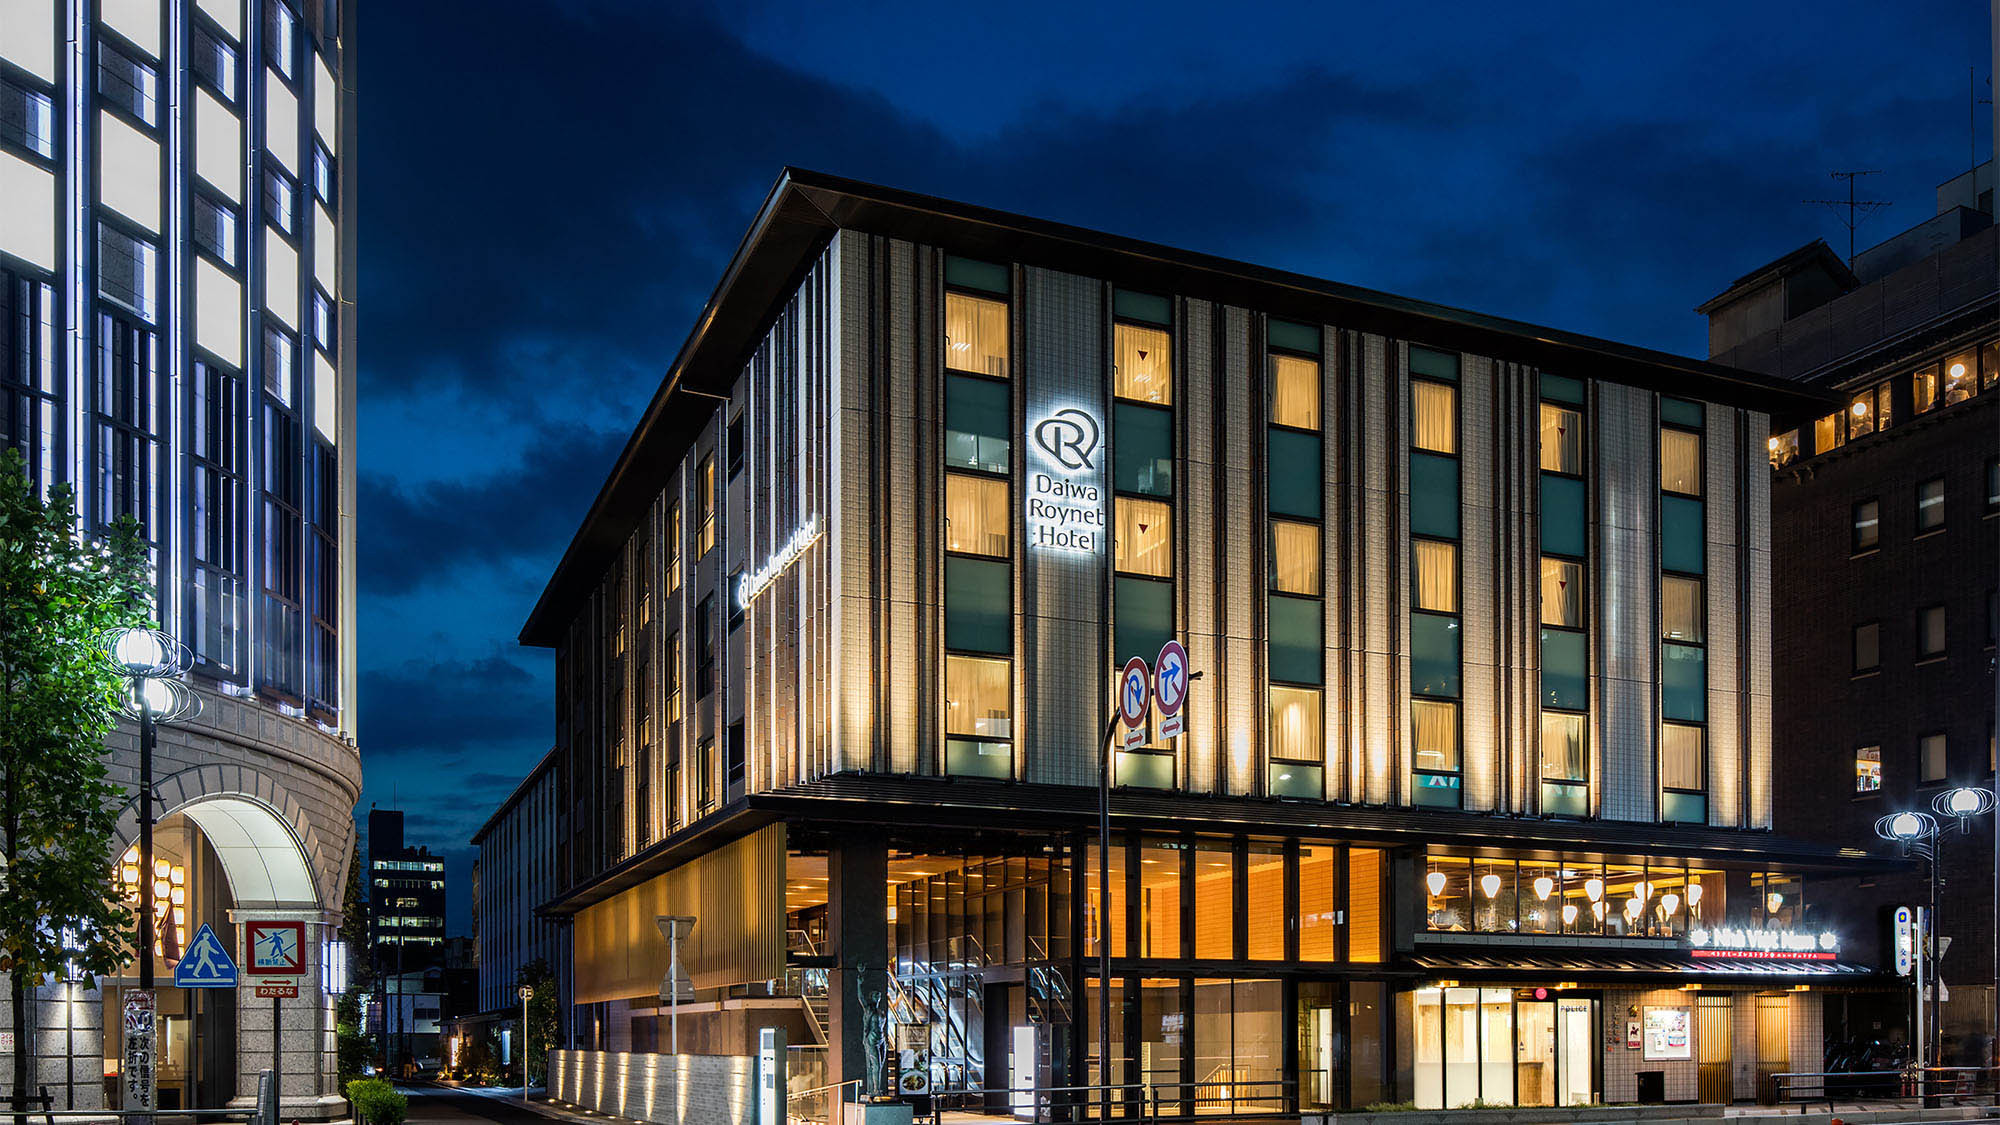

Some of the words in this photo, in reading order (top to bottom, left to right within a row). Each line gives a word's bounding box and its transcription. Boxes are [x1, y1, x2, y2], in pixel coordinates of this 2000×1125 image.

[1036, 474, 1098, 501] Daiwa
[1030, 498, 1104, 526] Roynet
[1040, 525, 1095, 550] Hotel
[260, 987, 294, 996] わたるな
[1560, 1005, 1588, 1013] POLICE
[127, 1036, 138, 1101] 左折です。
[140, 1036, 150, 1107] 次の信号を
